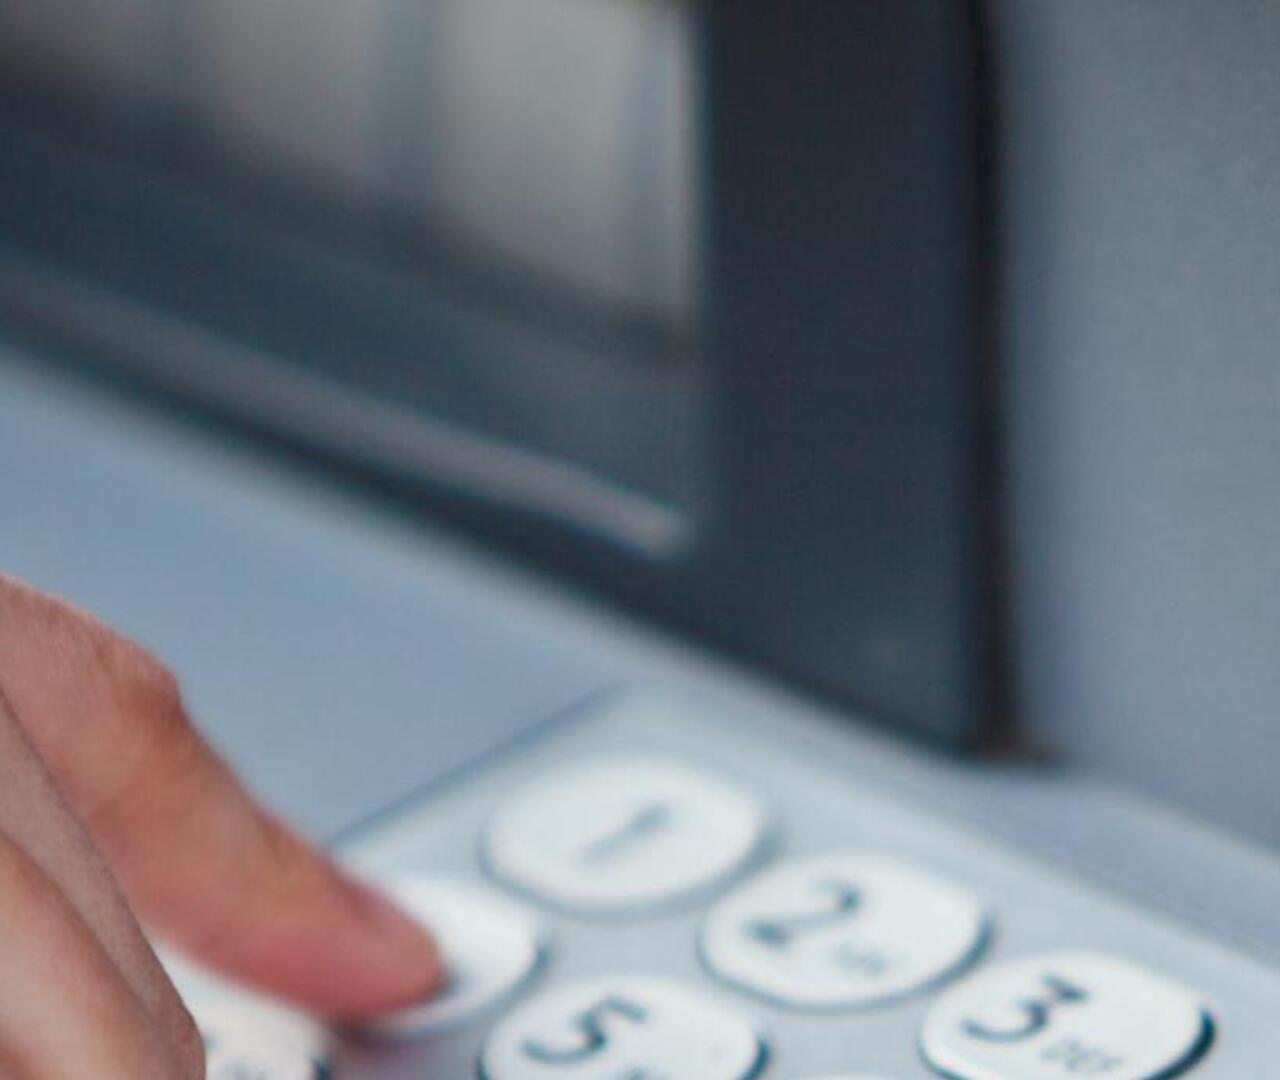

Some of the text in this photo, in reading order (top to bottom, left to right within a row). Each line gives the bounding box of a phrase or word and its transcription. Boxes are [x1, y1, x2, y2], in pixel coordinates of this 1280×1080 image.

[744, 878, 863, 948] 2
[523, 994, 650, 1064] 5
[962, 970, 1090, 1042] 3
